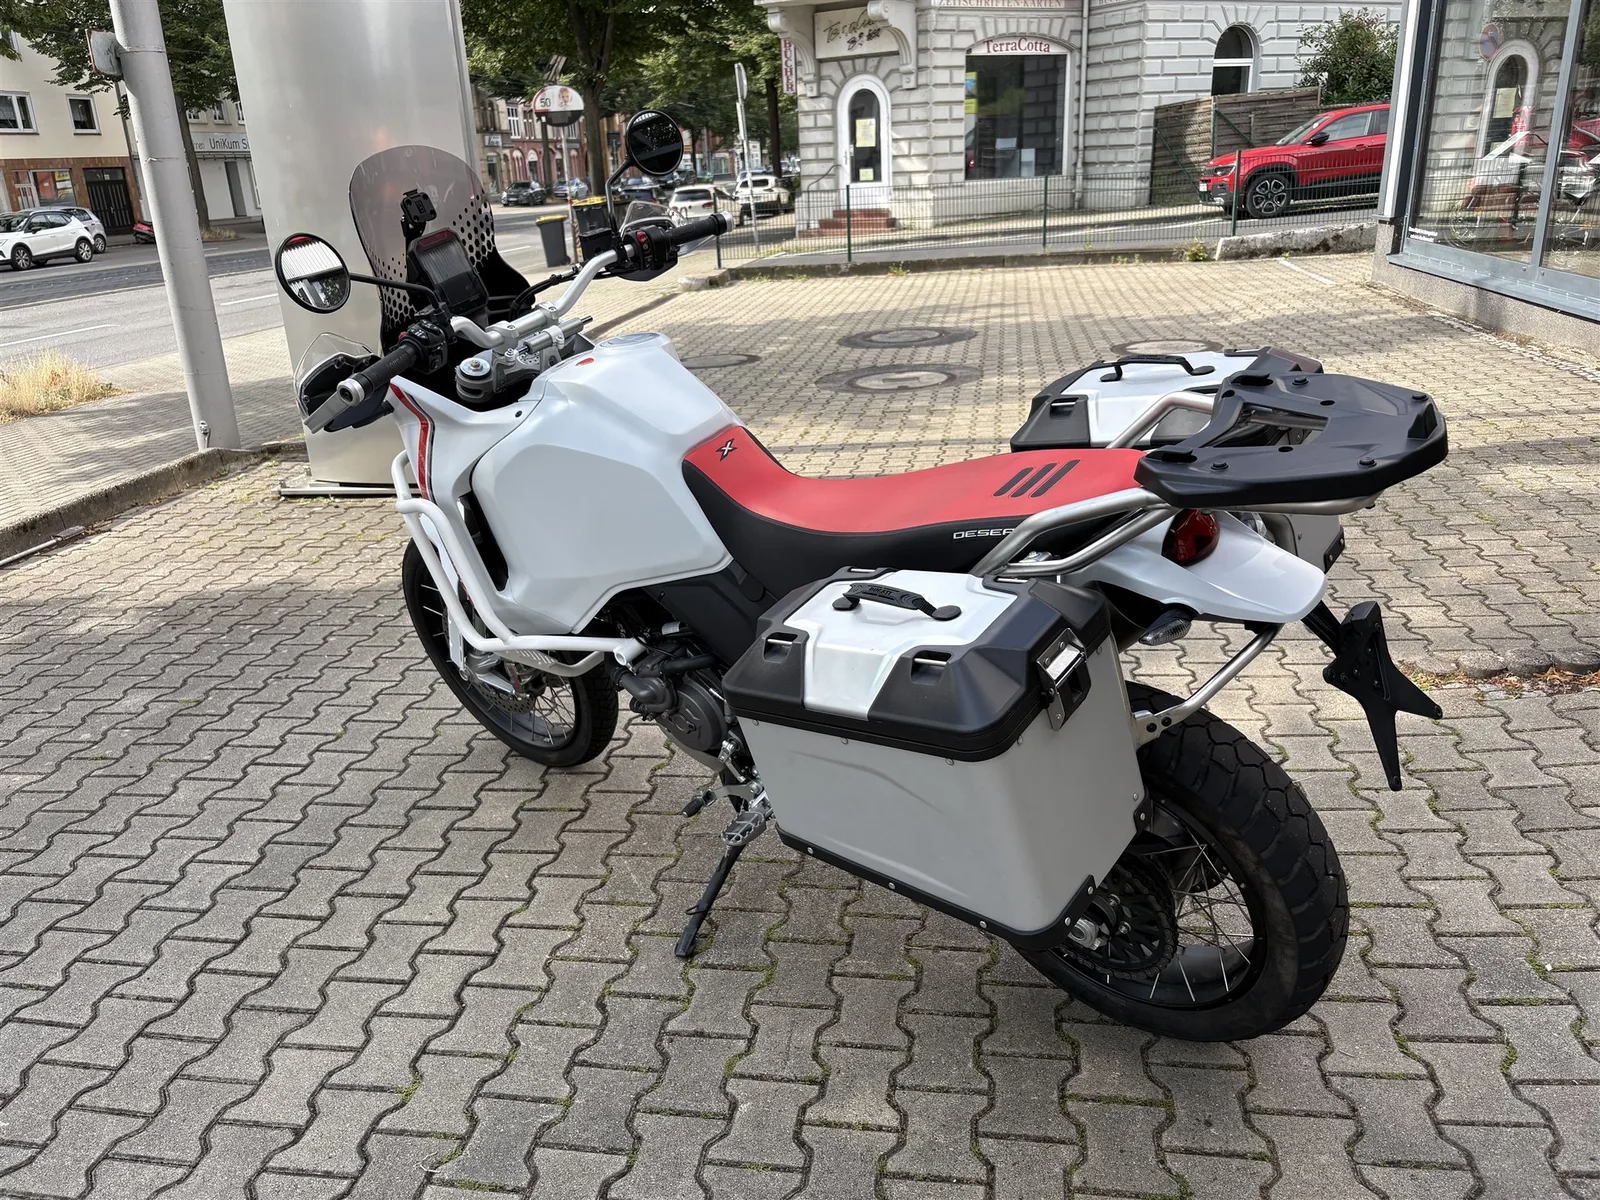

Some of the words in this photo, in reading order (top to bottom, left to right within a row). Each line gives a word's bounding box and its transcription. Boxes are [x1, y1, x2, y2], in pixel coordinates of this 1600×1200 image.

[984, 37, 1050, 53] TerraCotta
[784, 40, 794, 91] BÜCHER
[540, 97, 551, 107] 50
[209, 138, 240, 149] UniKum
